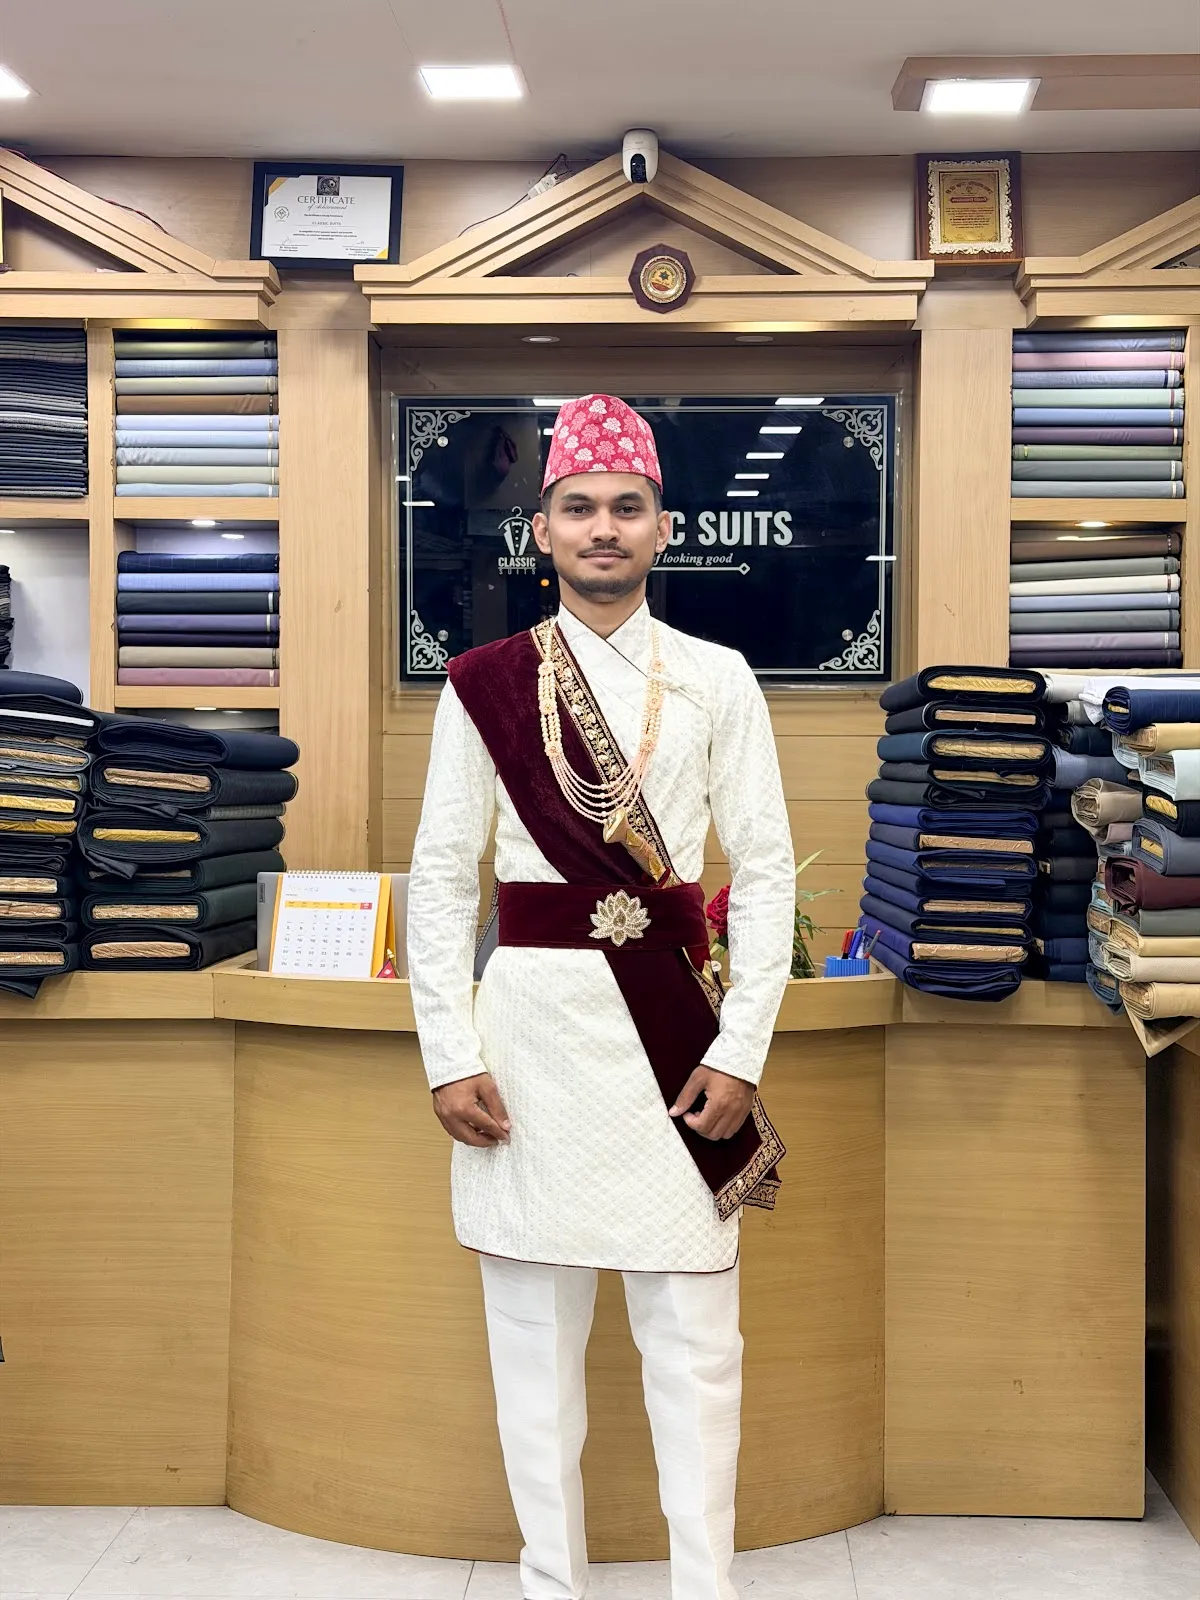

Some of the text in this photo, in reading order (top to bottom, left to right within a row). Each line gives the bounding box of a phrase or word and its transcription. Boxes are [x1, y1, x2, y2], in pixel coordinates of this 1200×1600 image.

[297, 195, 355, 205] CERTIFICATE
[697, 510, 793, 546] SUITS
[498, 556, 536, 568] CLASSIC
[653, 552, 734, 566] f looking good
[498, 567, 536, 575] SUITS
